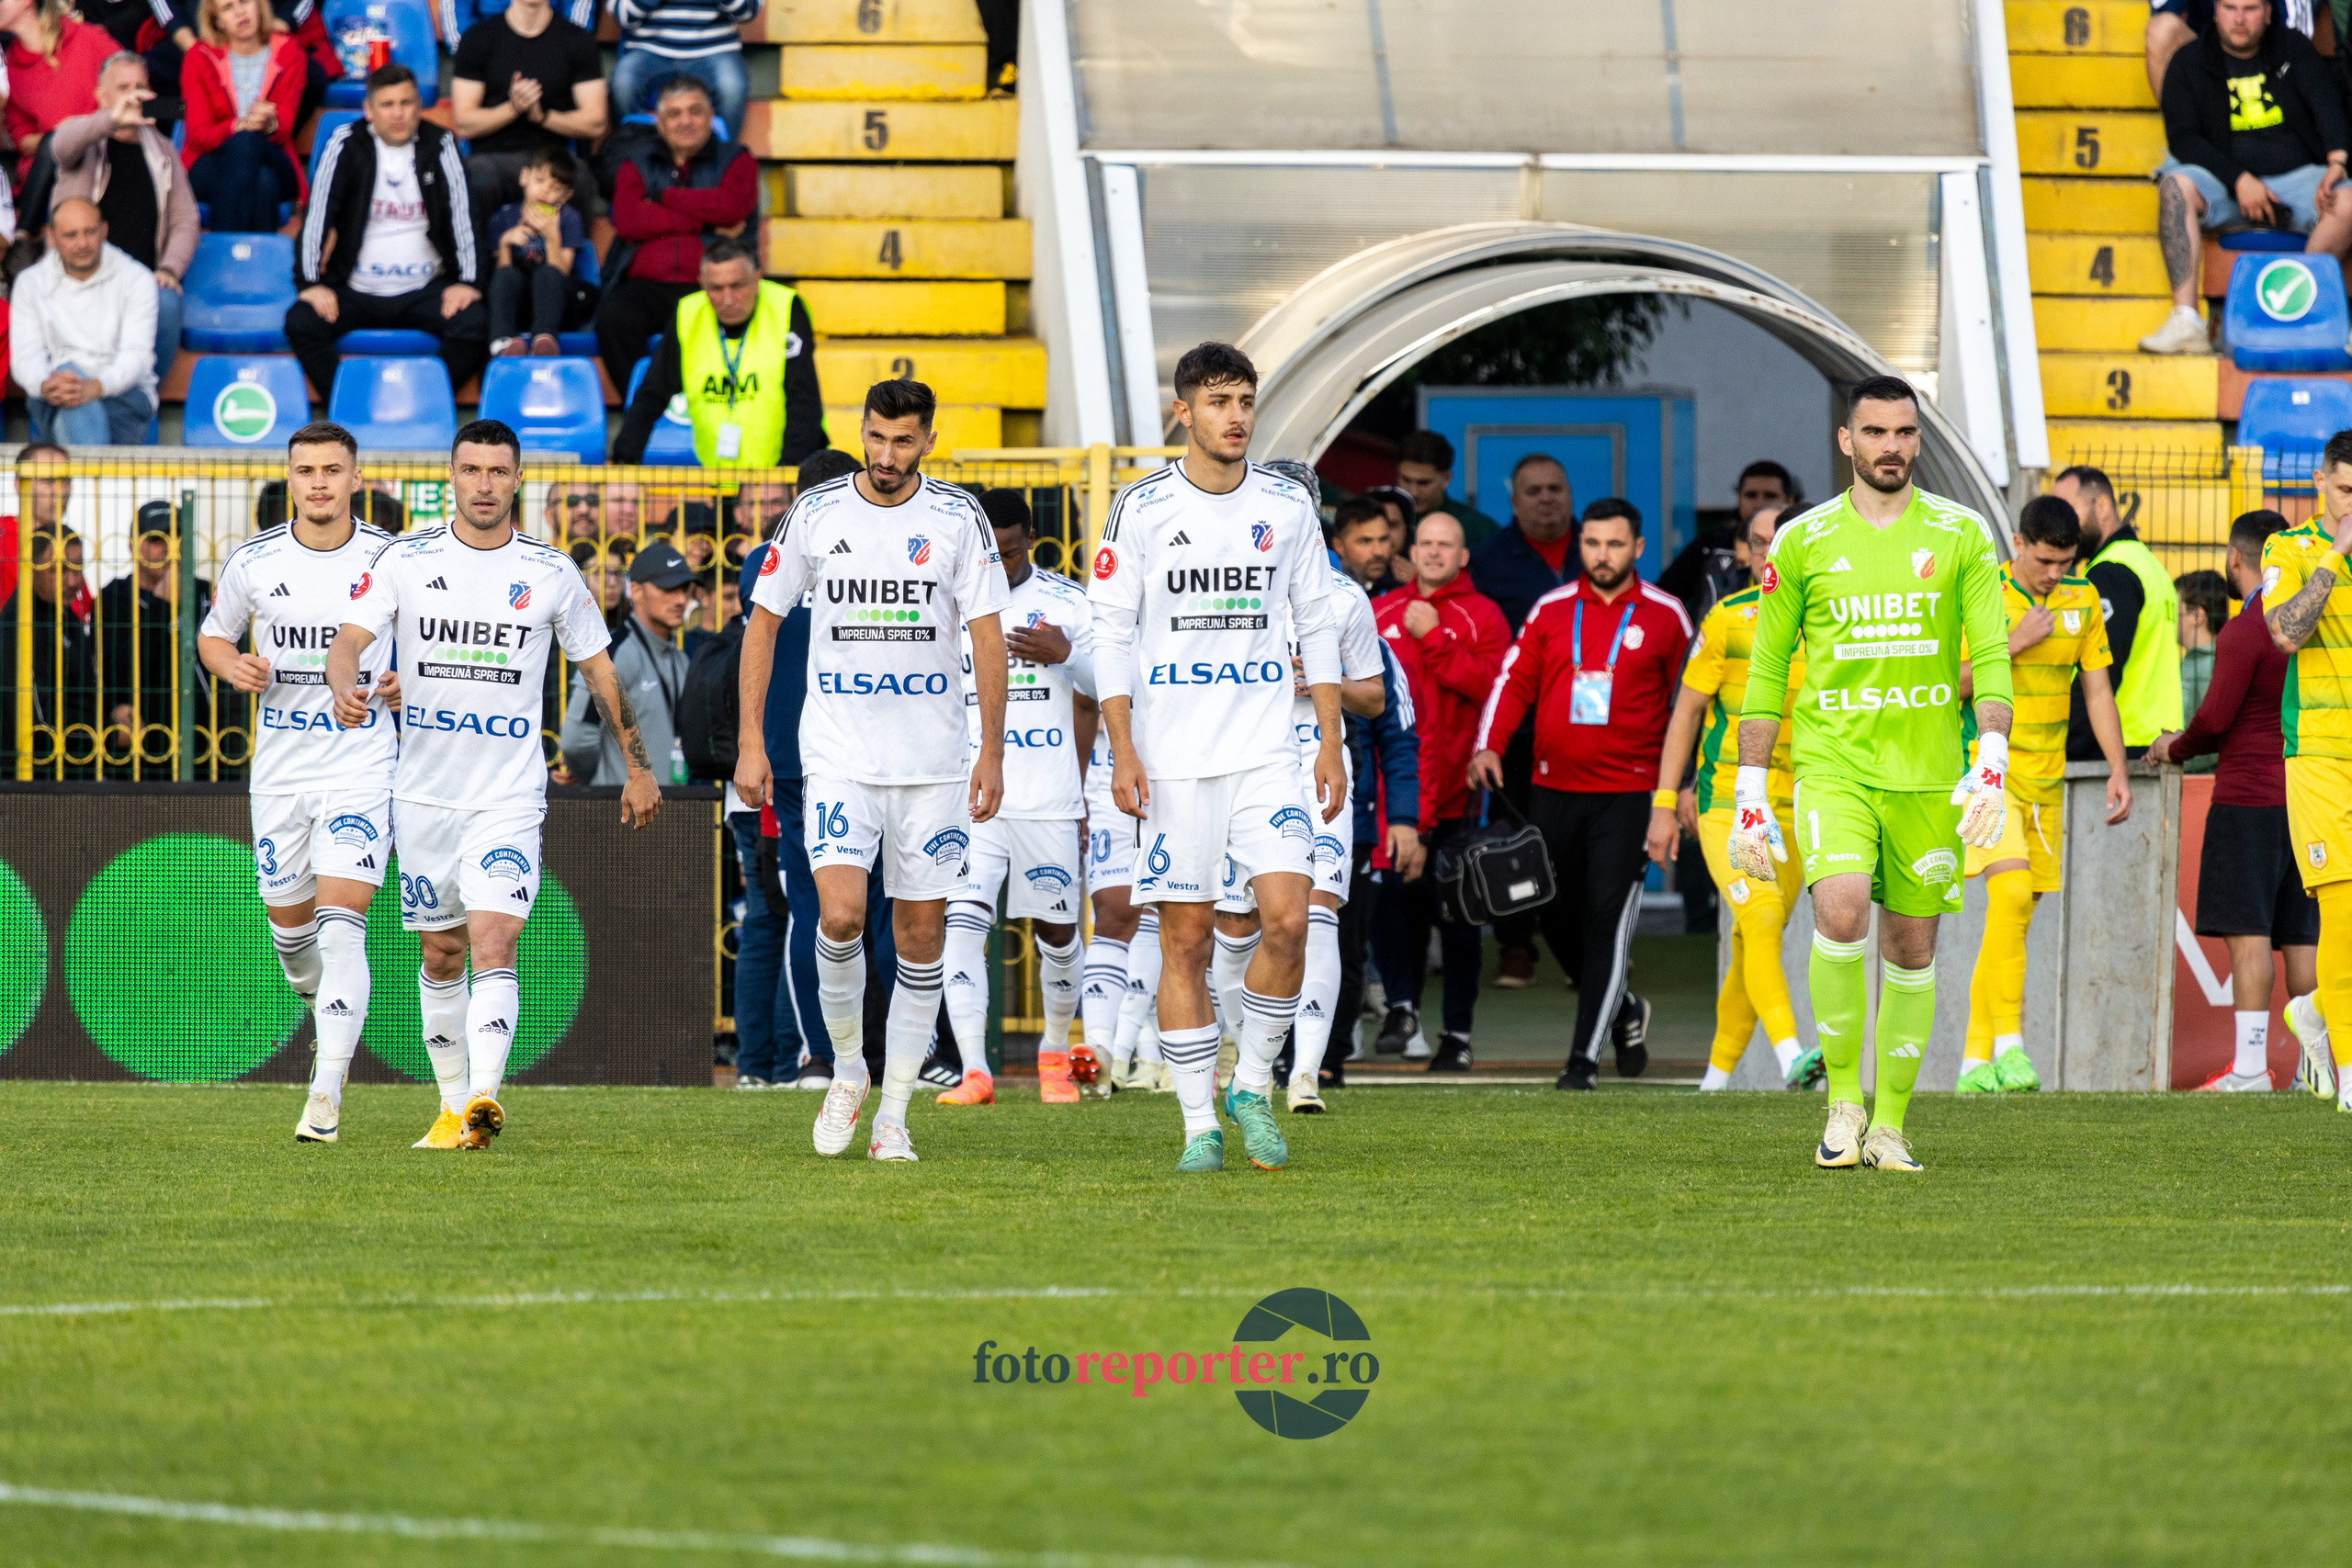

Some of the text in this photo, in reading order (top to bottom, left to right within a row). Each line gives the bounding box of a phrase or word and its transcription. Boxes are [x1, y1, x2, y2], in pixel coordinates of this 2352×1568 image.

[858, 0, 882, 34] 6
[2064, 7, 2090, 46] 6
[865, 111, 888, 151] 5
[2075, 127, 2100, 169] 5
[879, 231, 902, 270] 4
[2089, 246, 2115, 288] 4
[2107, 370, 2131, 410] 3
[1136, 492, 1174, 513] EECTROALFA
[1261, 487, 1306, 505] ELECTROALFA
[520, 554, 564, 573] ELECTROALFA
[1167, 566, 1277, 594] UNIBET
[827, 579, 938, 605] UNIBET
[1828, 592, 1941, 623] UNIBET
[419, 616, 532, 649] UNIBET
[837, 626, 931, 640] ÎMPREUNĂ SPRE 0%
[1177, 615, 1227, 630] ÎMPREUNĂ
[1228, 617, 1254, 629] SPRE
[272, 625, 338, 649] UNIB
[1840, 642, 1933, 659] ÎMPREUNĂ SPRE 0%
[278, 671, 324, 684] ÎMPREUNĂ
[423, 662, 515, 683] ÎMPREUNĂ SPRE 0%
[818, 672, 948, 695] ELSACO
[1148, 660, 1283, 685] ELSACO
[1007, 690, 1046, 701] SPRE 0%
[1818, 683, 1951, 711] ELSACO
[406, 705, 530, 739] ELSACO
[1003, 728, 1063, 748] ACO
[816, 801, 850, 840] 16
[1272, 812, 1286, 826] FIVE
[1807, 809, 1821, 850] 1
[836, 845, 865, 857] Vestra
[926, 840, 940, 854] FIVE
[1148, 832, 1170, 875] 6
[1826, 852, 1861, 863] Vestra
[482, 851, 529, 873] FIVE CONTINENTS
[1101, 866, 1130, 876] Vestra
[267, 873, 298, 887] Vestra
[400, 872, 439, 909] 30
[1167, 880, 1200, 891] Vestra
[424, 913, 455, 922] Vestra
[322, 1009, 354, 1017] adidas
[1298, 1010, 1325, 1019] adidas
